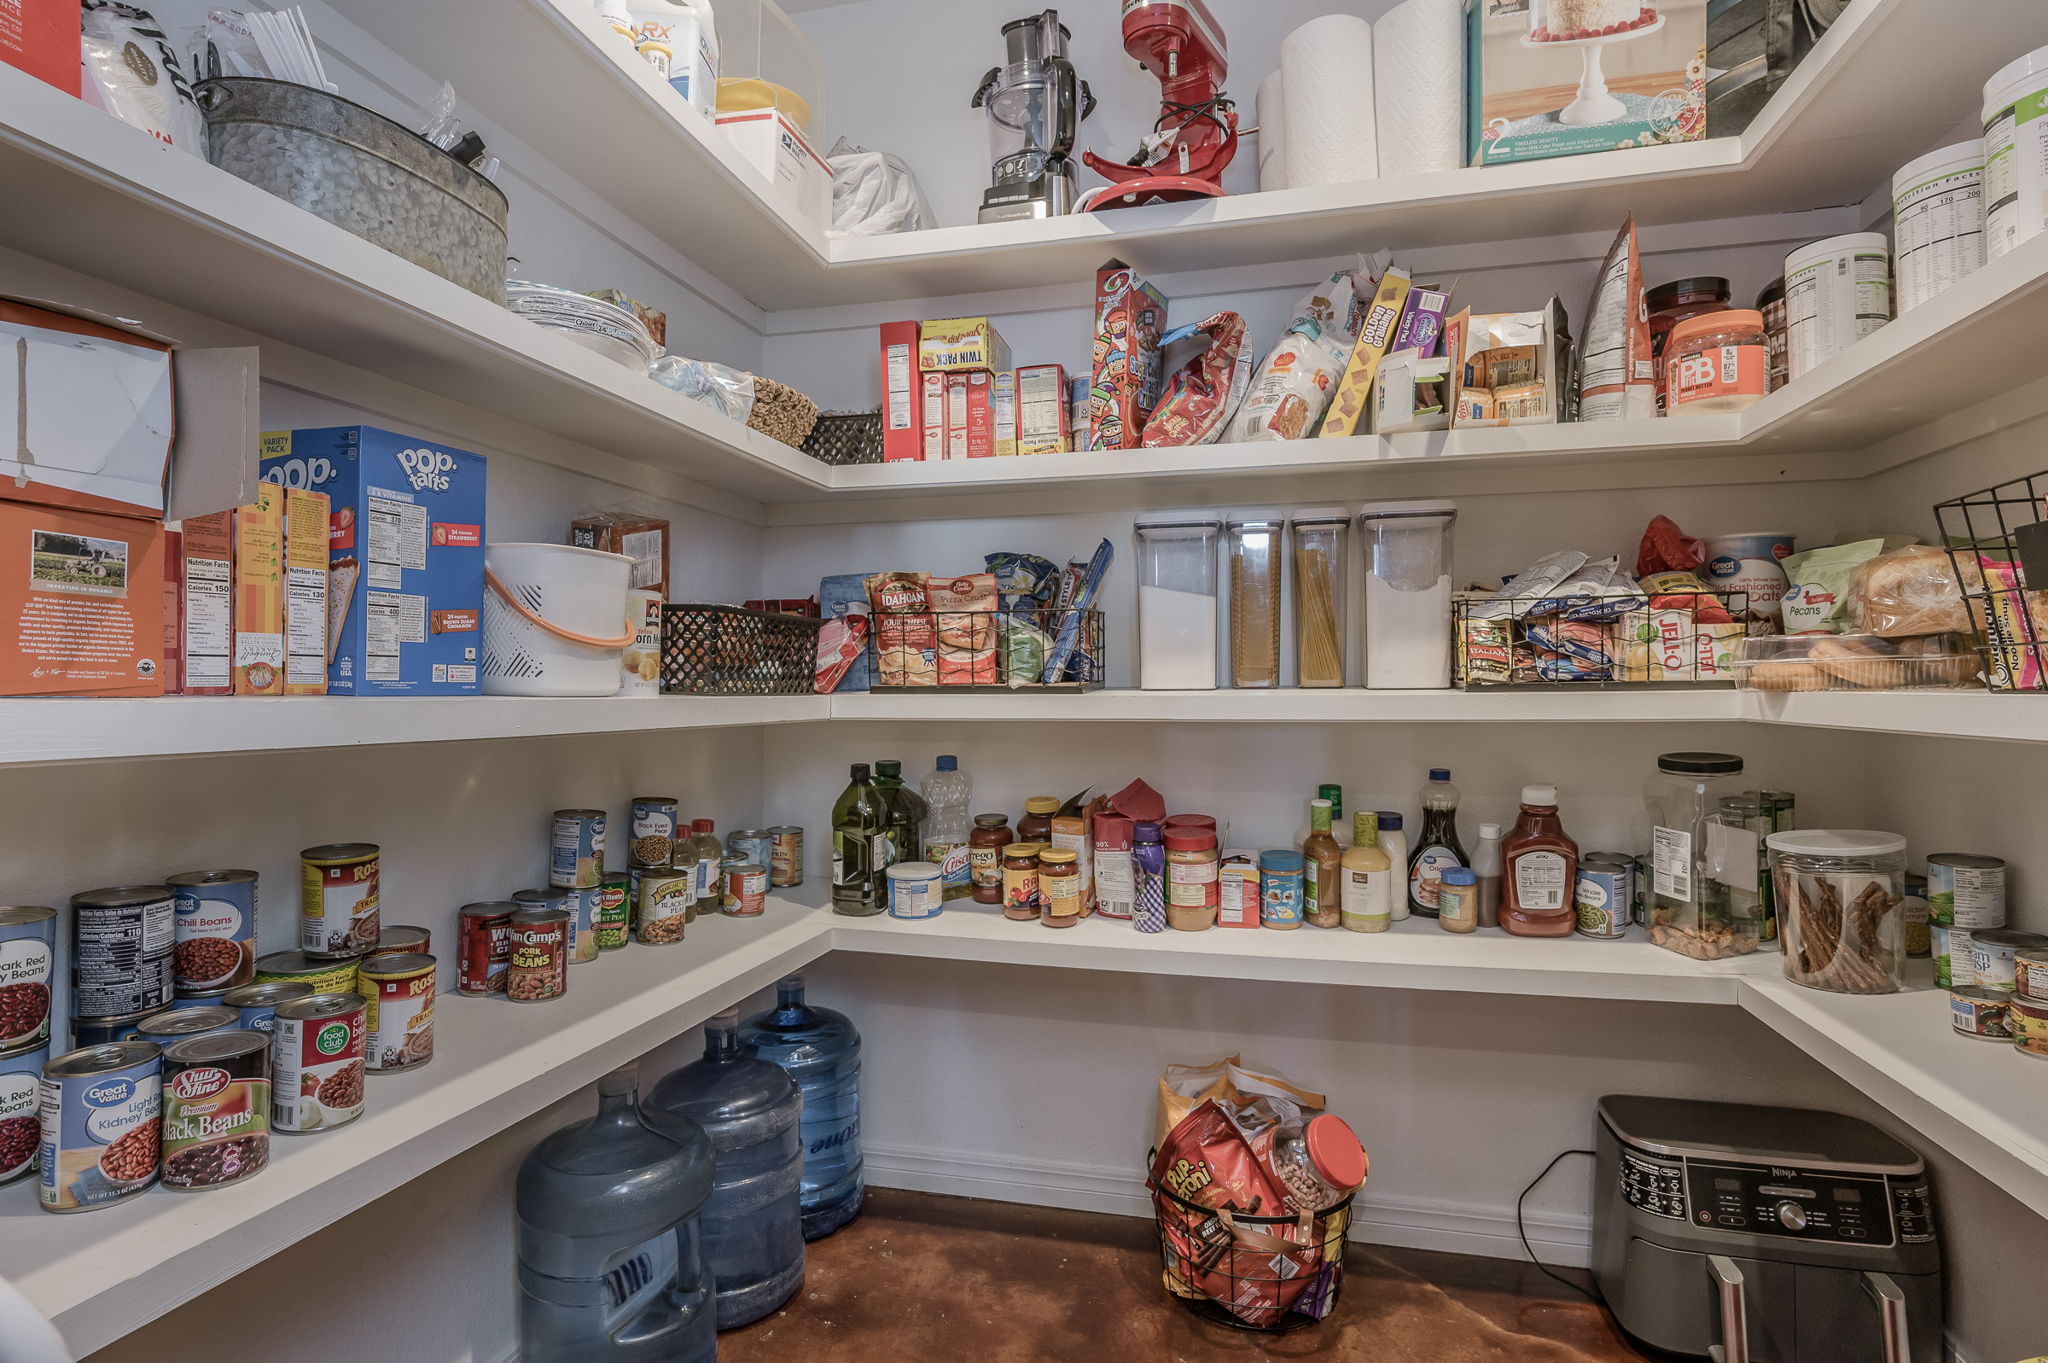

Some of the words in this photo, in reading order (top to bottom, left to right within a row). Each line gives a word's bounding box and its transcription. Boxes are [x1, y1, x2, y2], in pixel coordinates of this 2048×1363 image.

[1945, 171, 1981, 183] Facts
[936, 353, 957, 366] PACK
[960, 351, 982, 364] TWIN
[263, 437, 289, 447] VARIETY
[266, 445, 286, 453] PACK
[409, 472, 450, 491] tarts
[188, 559, 213, 568] Nutrition
[214, 561, 229, 569] Facts
[1711, 561, 1735, 570] Great
[289, 568, 310, 576] Nutrition
[311, 570, 325, 578] Facts
[215, 585, 230, 593] 150
[1729, 583, 1781, 591] Fashioned
[289, 590, 310, 598] Calories
[312, 591, 325, 599] 130
[881, 591, 926, 607] IDAHOAN
[941, 595, 963, 603] Pizza
[963, 594, 988, 602] Crust
[1749, 591, 1781, 603] Oats
[1790, 606, 1821, 616] Pecans
[636, 635, 651, 645] orn
[971, 850, 994, 865] rego
[1582, 888, 1601, 896] Whole
[175, 899, 195, 907] reat
[177, 918, 197, 927] Chili
[199, 916, 233, 927] Beans
[127, 928, 141, 936] 110
[523, 929, 561, 945] Camp's
[519, 947, 541, 956] PORK
[25, 953, 46, 967] Red
[513, 954, 550, 968] BEANS
[11, 965, 46, 980] Beans
[323, 1030, 345, 1040] food
[323, 1038, 343, 1047] club
[11, 1086, 34, 1099] Red
[89, 1083, 128, 1099] Great
[99, 1092, 128, 1103] Value
[129, 1096, 153, 1113] Light
[180, 1102, 218, 1117] Premium
[98, 1113, 143, 1130] Kidney
[199, 1108, 253, 1136] Beans
[1772, 1167, 1798, 1179] NINJA
[1202, 1226, 1217, 1238] BEEF
